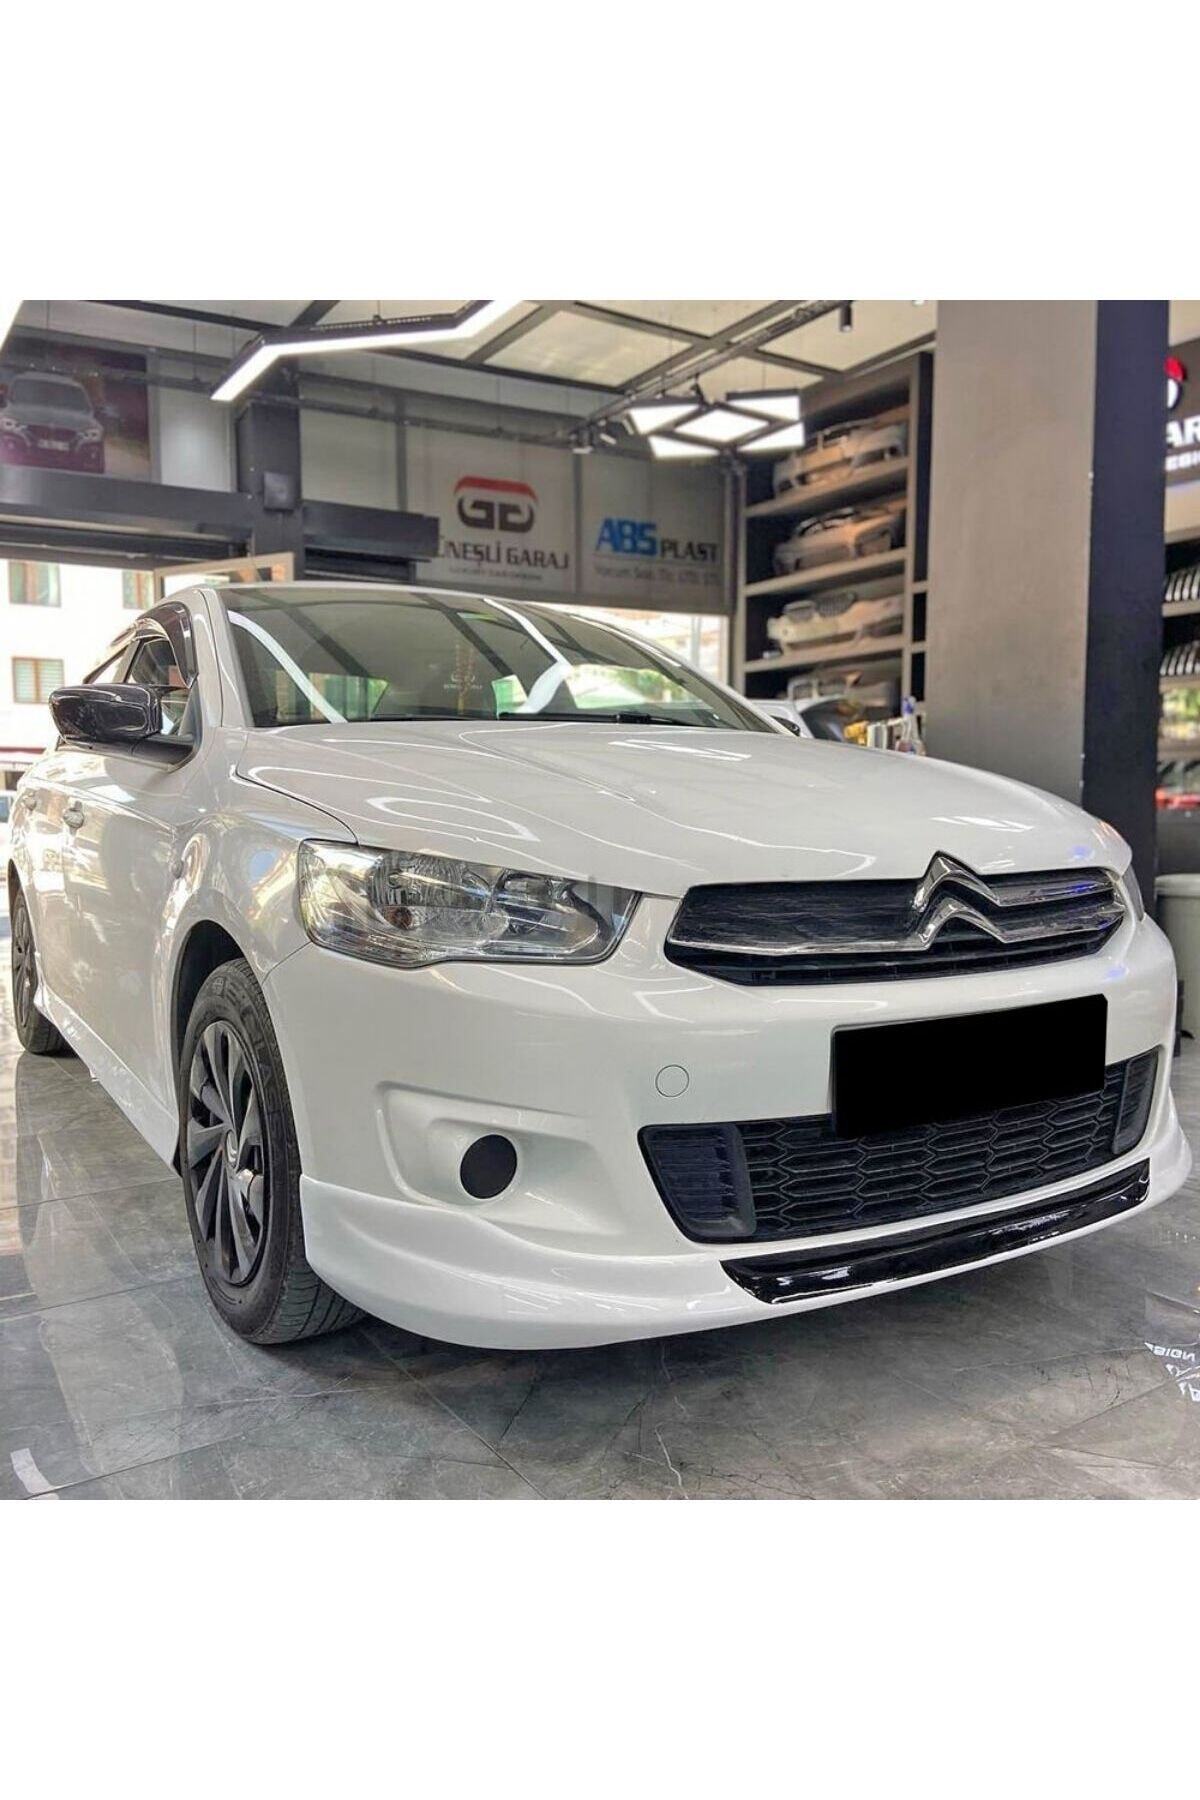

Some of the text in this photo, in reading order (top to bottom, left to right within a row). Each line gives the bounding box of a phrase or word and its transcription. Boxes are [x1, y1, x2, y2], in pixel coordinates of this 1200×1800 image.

[596, 517, 719, 562] ABS PLAST
[506, 546, 569, 570] GARAJ
